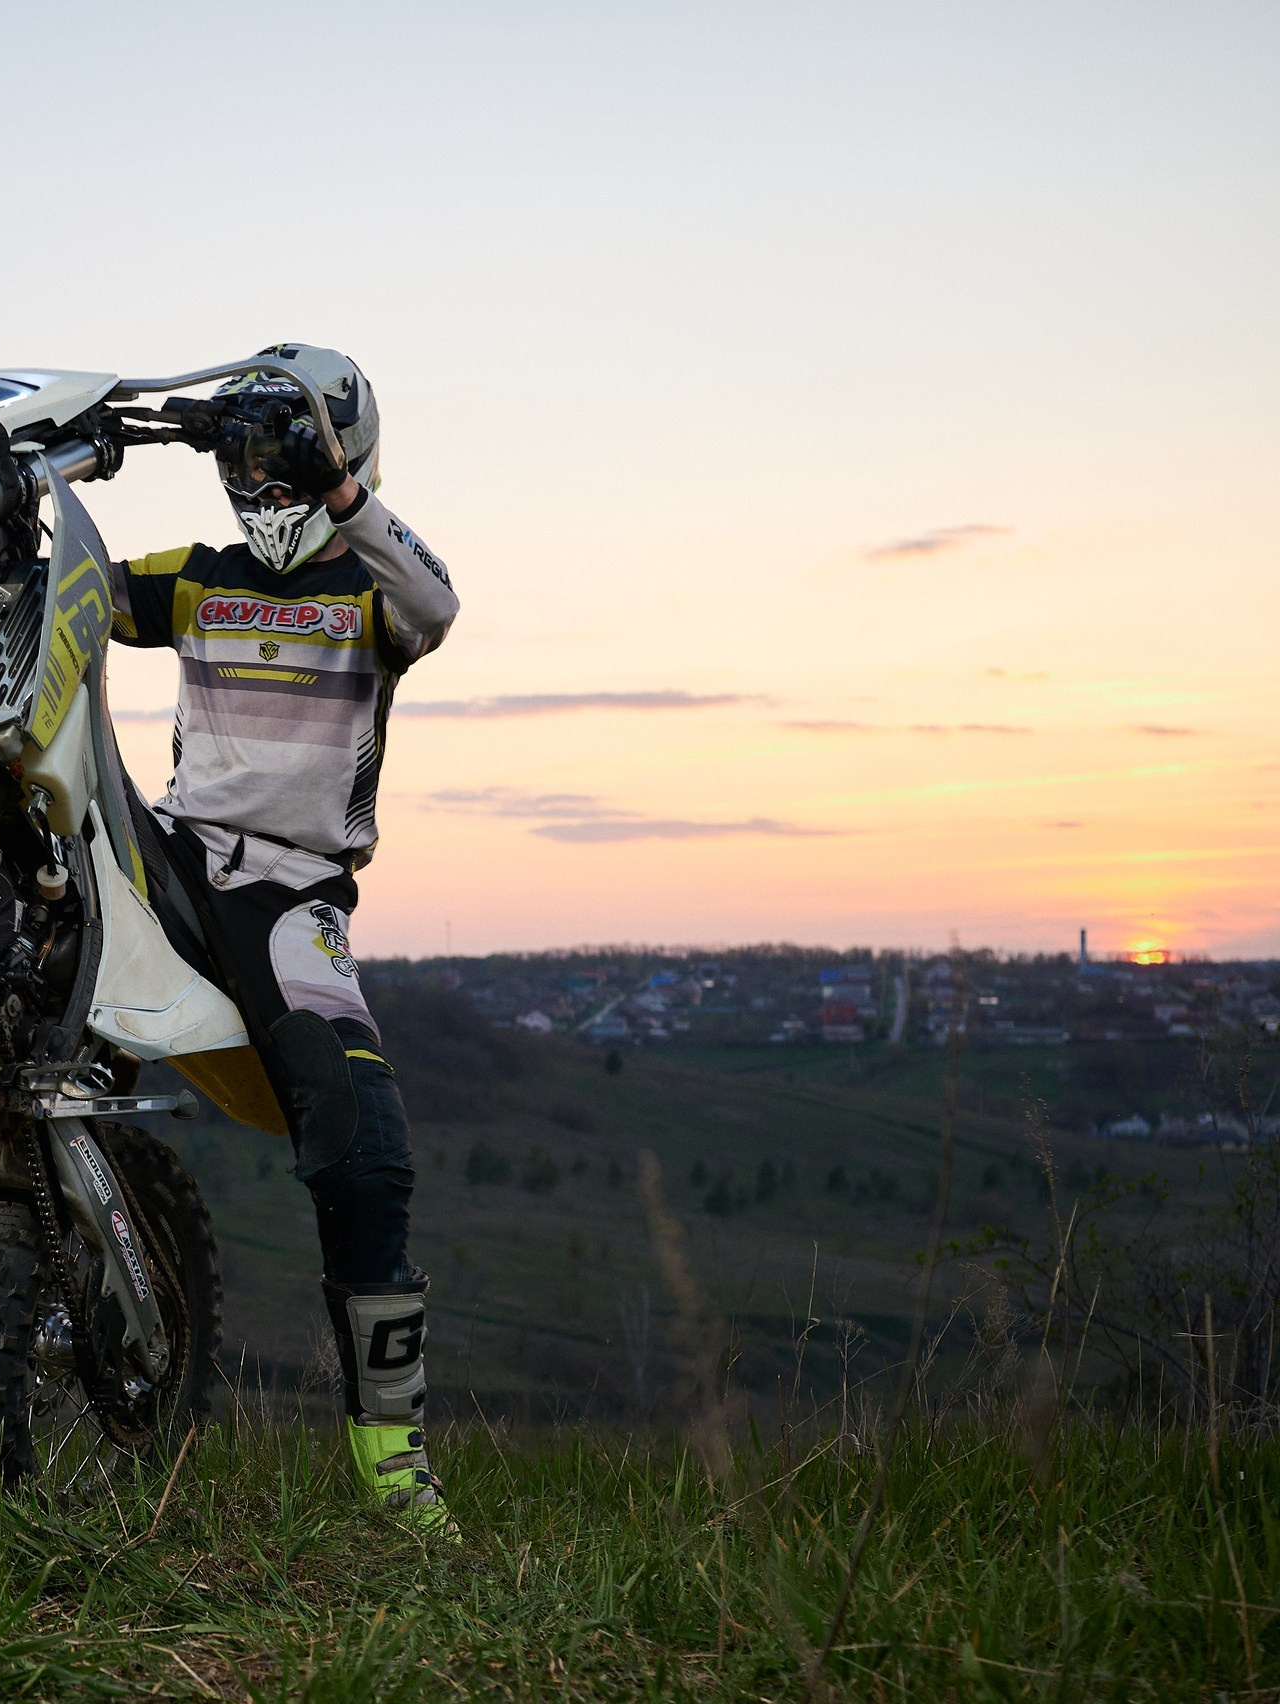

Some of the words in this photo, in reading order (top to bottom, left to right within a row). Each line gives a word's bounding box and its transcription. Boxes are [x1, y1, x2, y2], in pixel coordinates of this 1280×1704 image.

[288, 526, 303, 556] Airoh
[200, 601, 321, 625] СКУТЕР
[328, 607, 356, 631] 31
[41, 710, 54, 729] TE
[79, 1139, 112, 1198] ENDURO
[121, 1235, 150, 1299] MAXIMA
